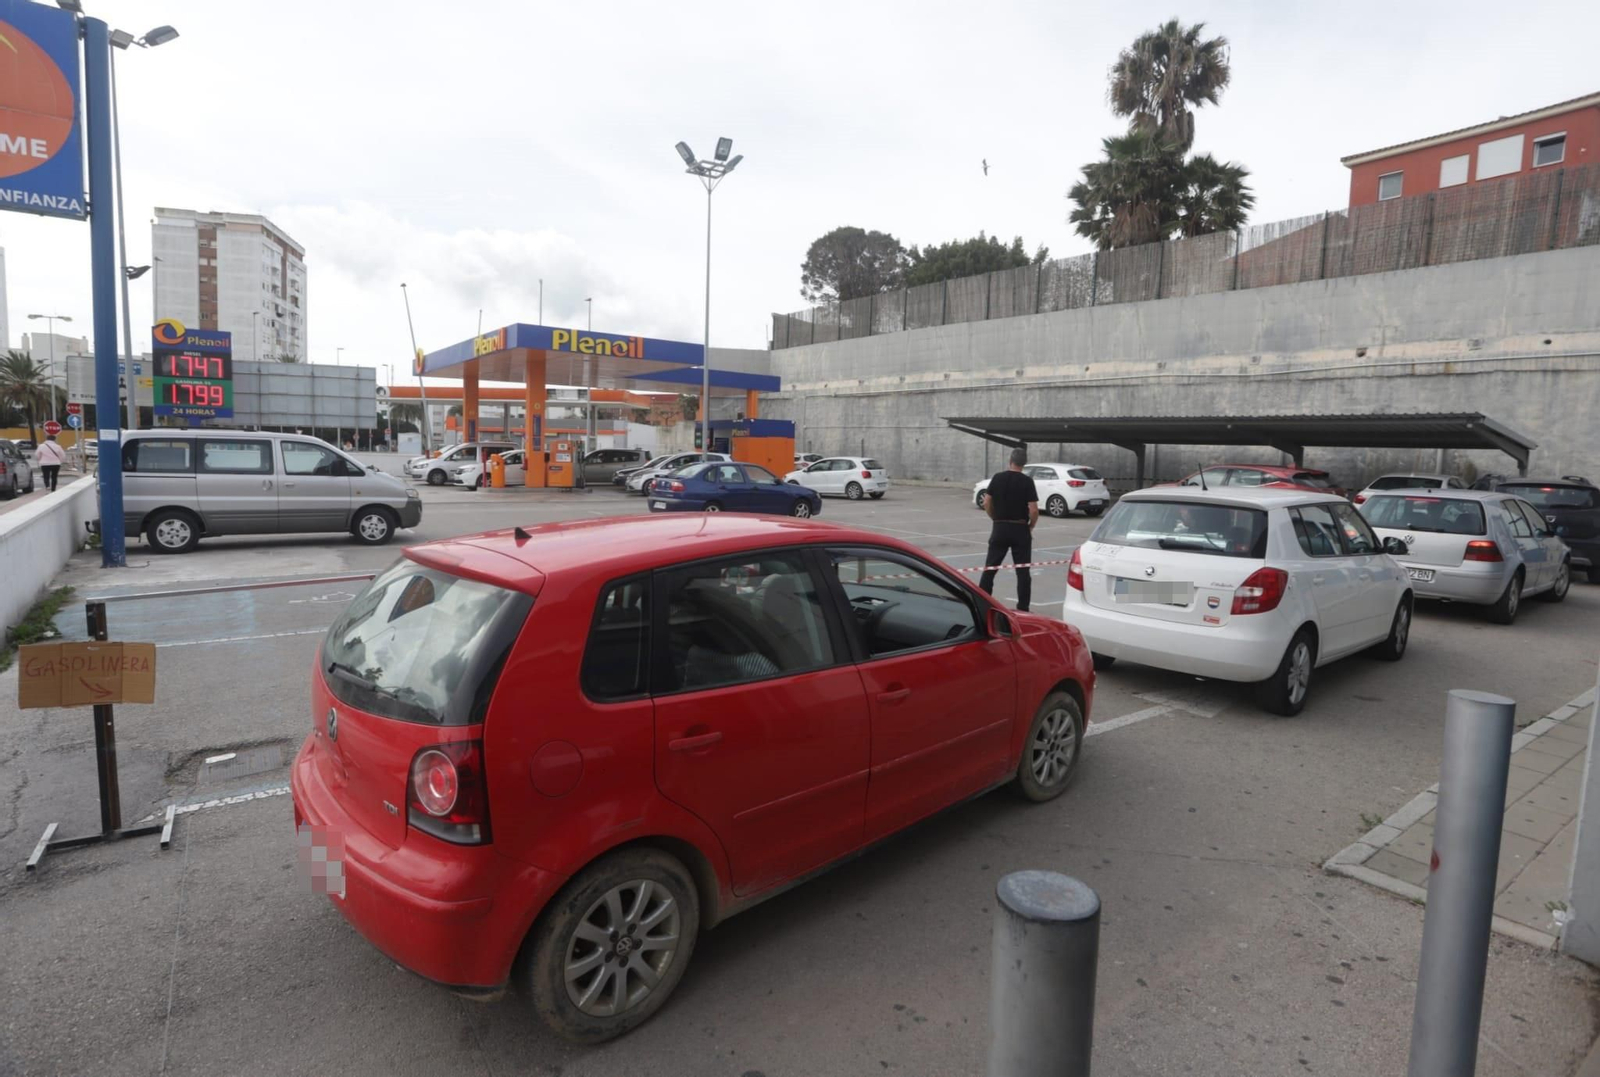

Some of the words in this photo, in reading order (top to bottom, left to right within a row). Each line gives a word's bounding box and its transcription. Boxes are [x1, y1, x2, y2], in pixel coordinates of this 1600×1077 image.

[187, 336, 229, 347] Plenoil
[474, 327, 507, 356] Plenoil
[552, 329, 644, 358] Plenoil
[171, 356, 223, 377] 1.747
[172, 384, 223, 406] 1.799
[25, 656, 150, 677] GASOLINERA
